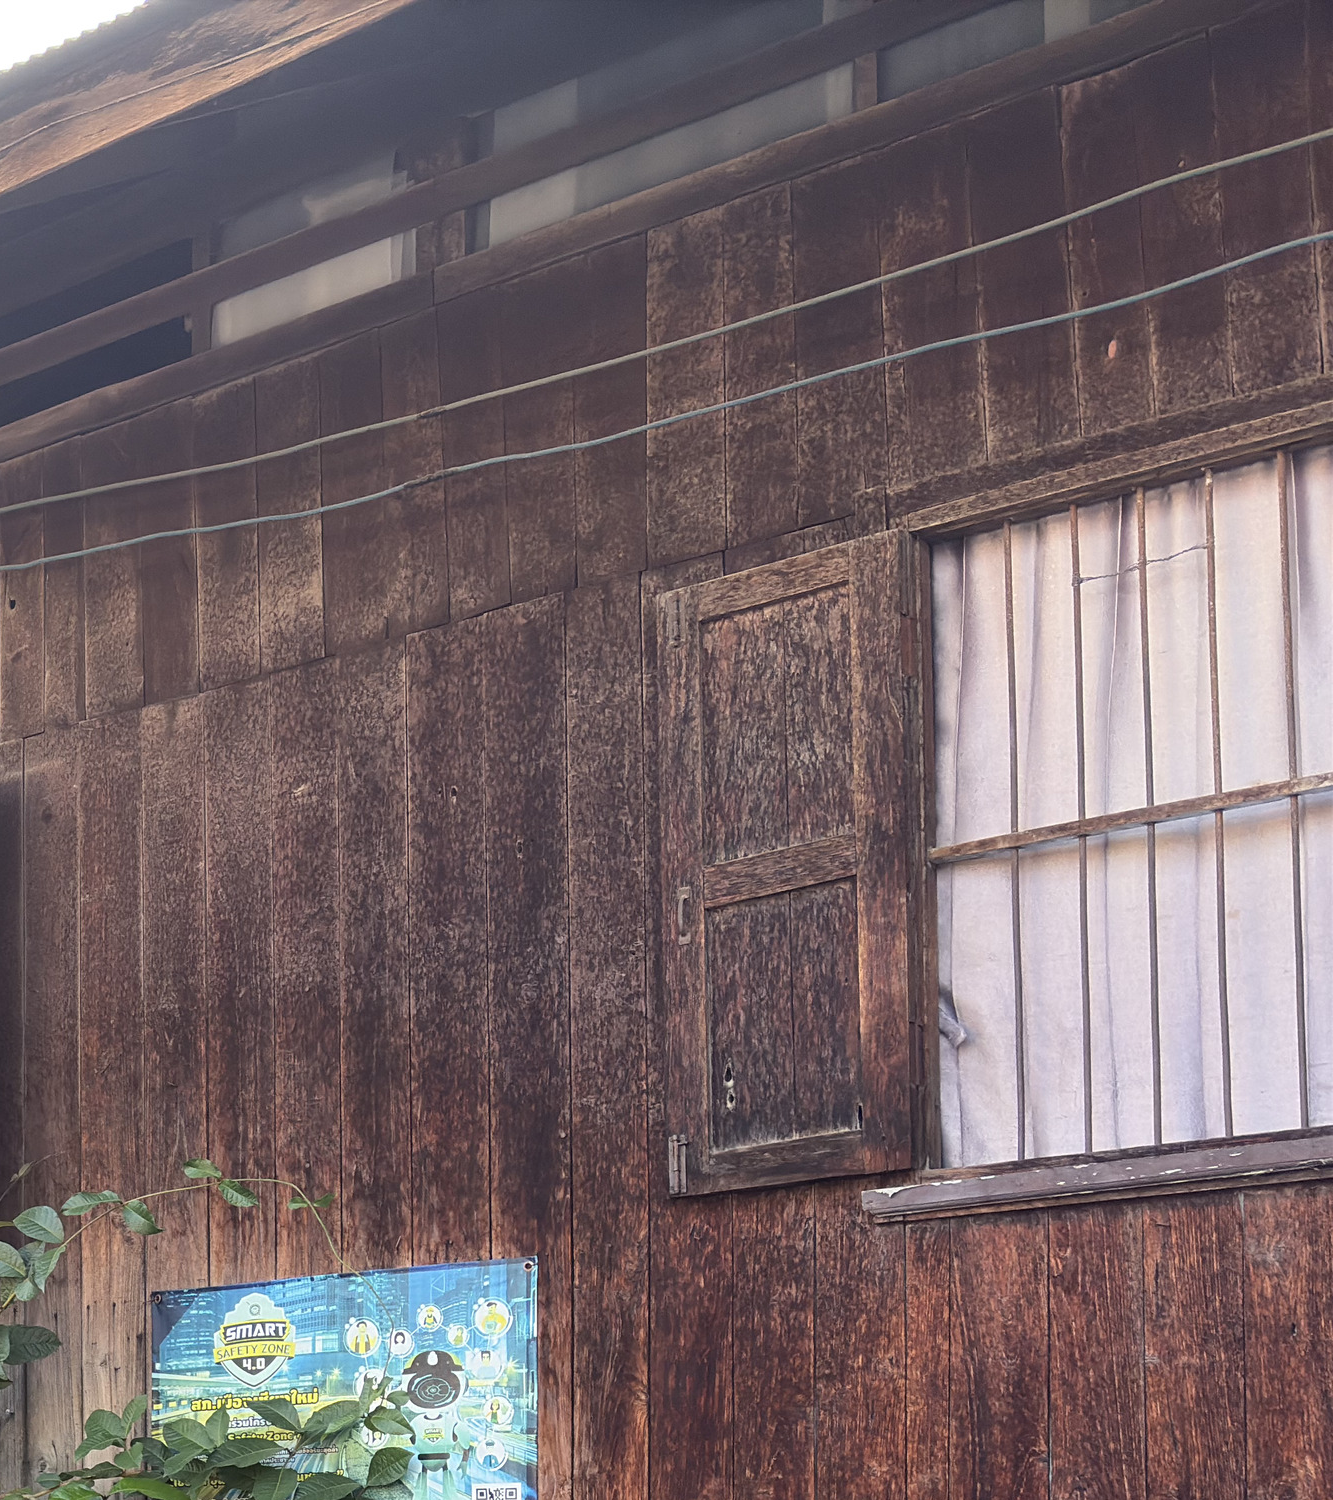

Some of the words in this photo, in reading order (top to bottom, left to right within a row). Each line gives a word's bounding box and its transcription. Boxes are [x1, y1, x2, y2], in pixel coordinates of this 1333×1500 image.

[226, 1323, 286, 1341] SMART
[216, 1344, 258, 1360] SAFETY
[261, 1343, 291, 1355] ZONE
[242, 1357, 266, 1370] 4.0
